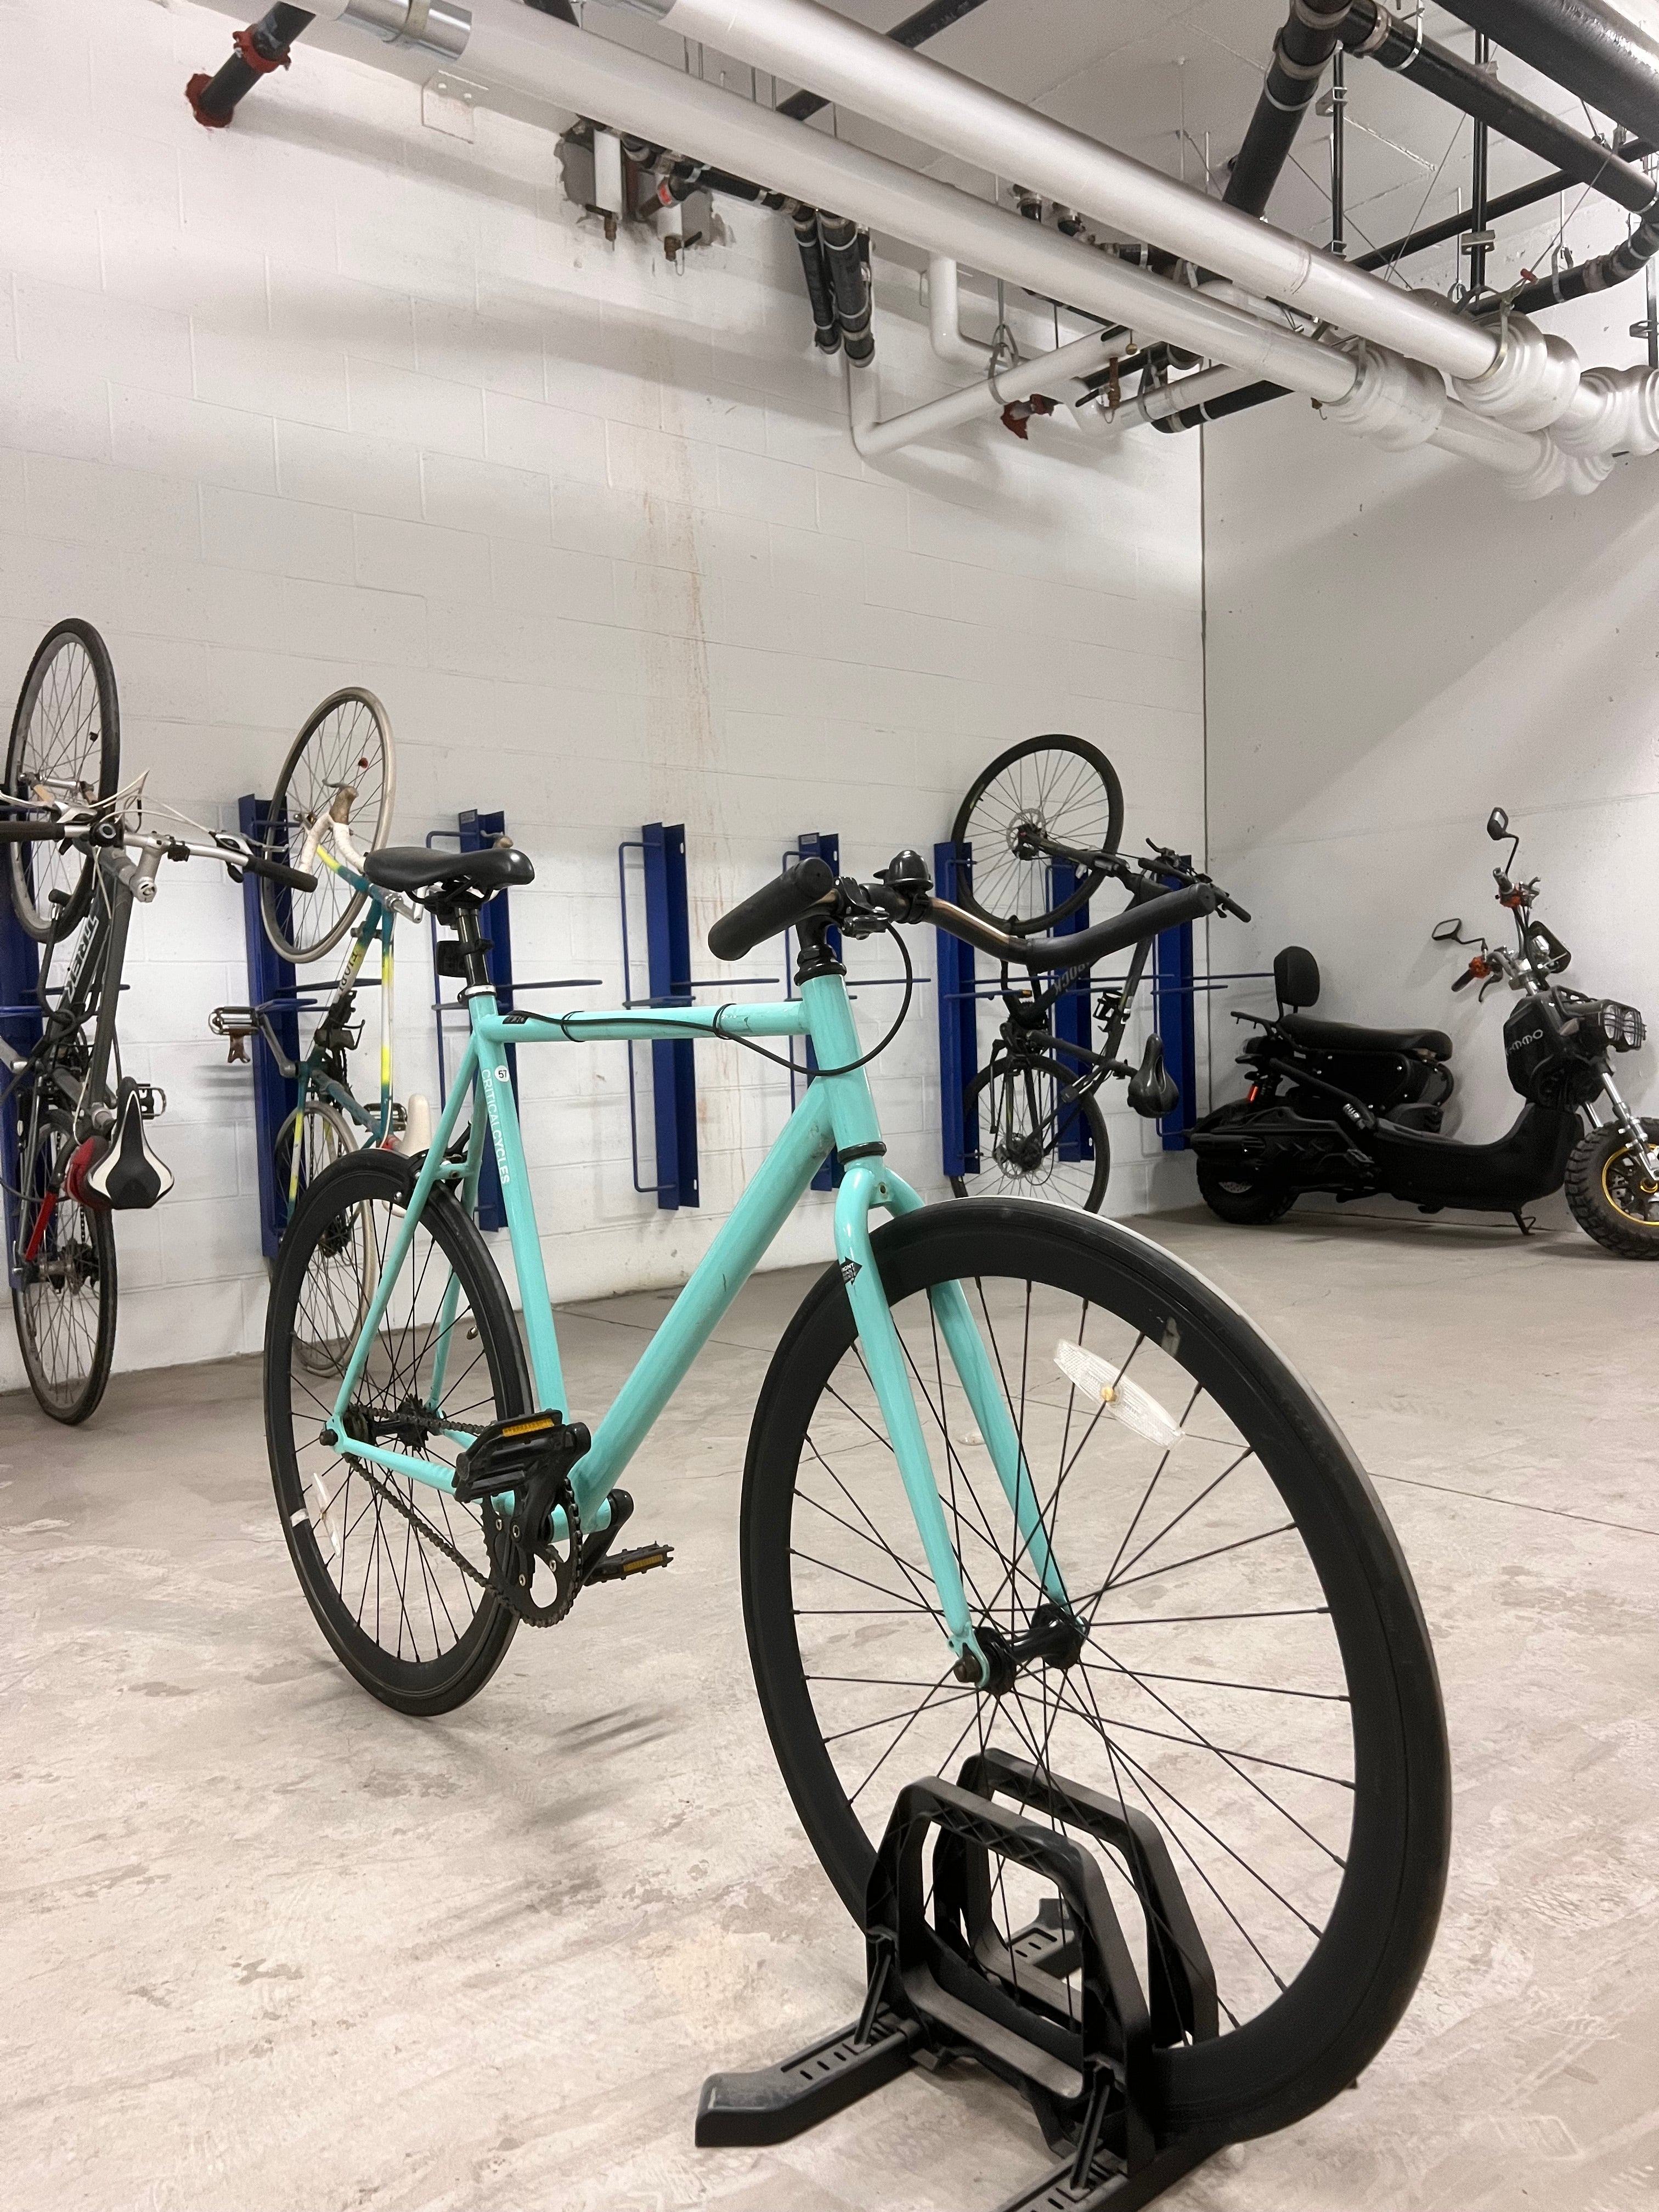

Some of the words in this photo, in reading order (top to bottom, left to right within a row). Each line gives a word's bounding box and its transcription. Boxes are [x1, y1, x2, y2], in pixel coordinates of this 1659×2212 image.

[64, 916, 99, 1003] TREK
[498, 1070, 507, 1079] 57
[482, 1069, 500, 1131] CRITICAL
[493, 1130, 510, 1184] CYCLES
